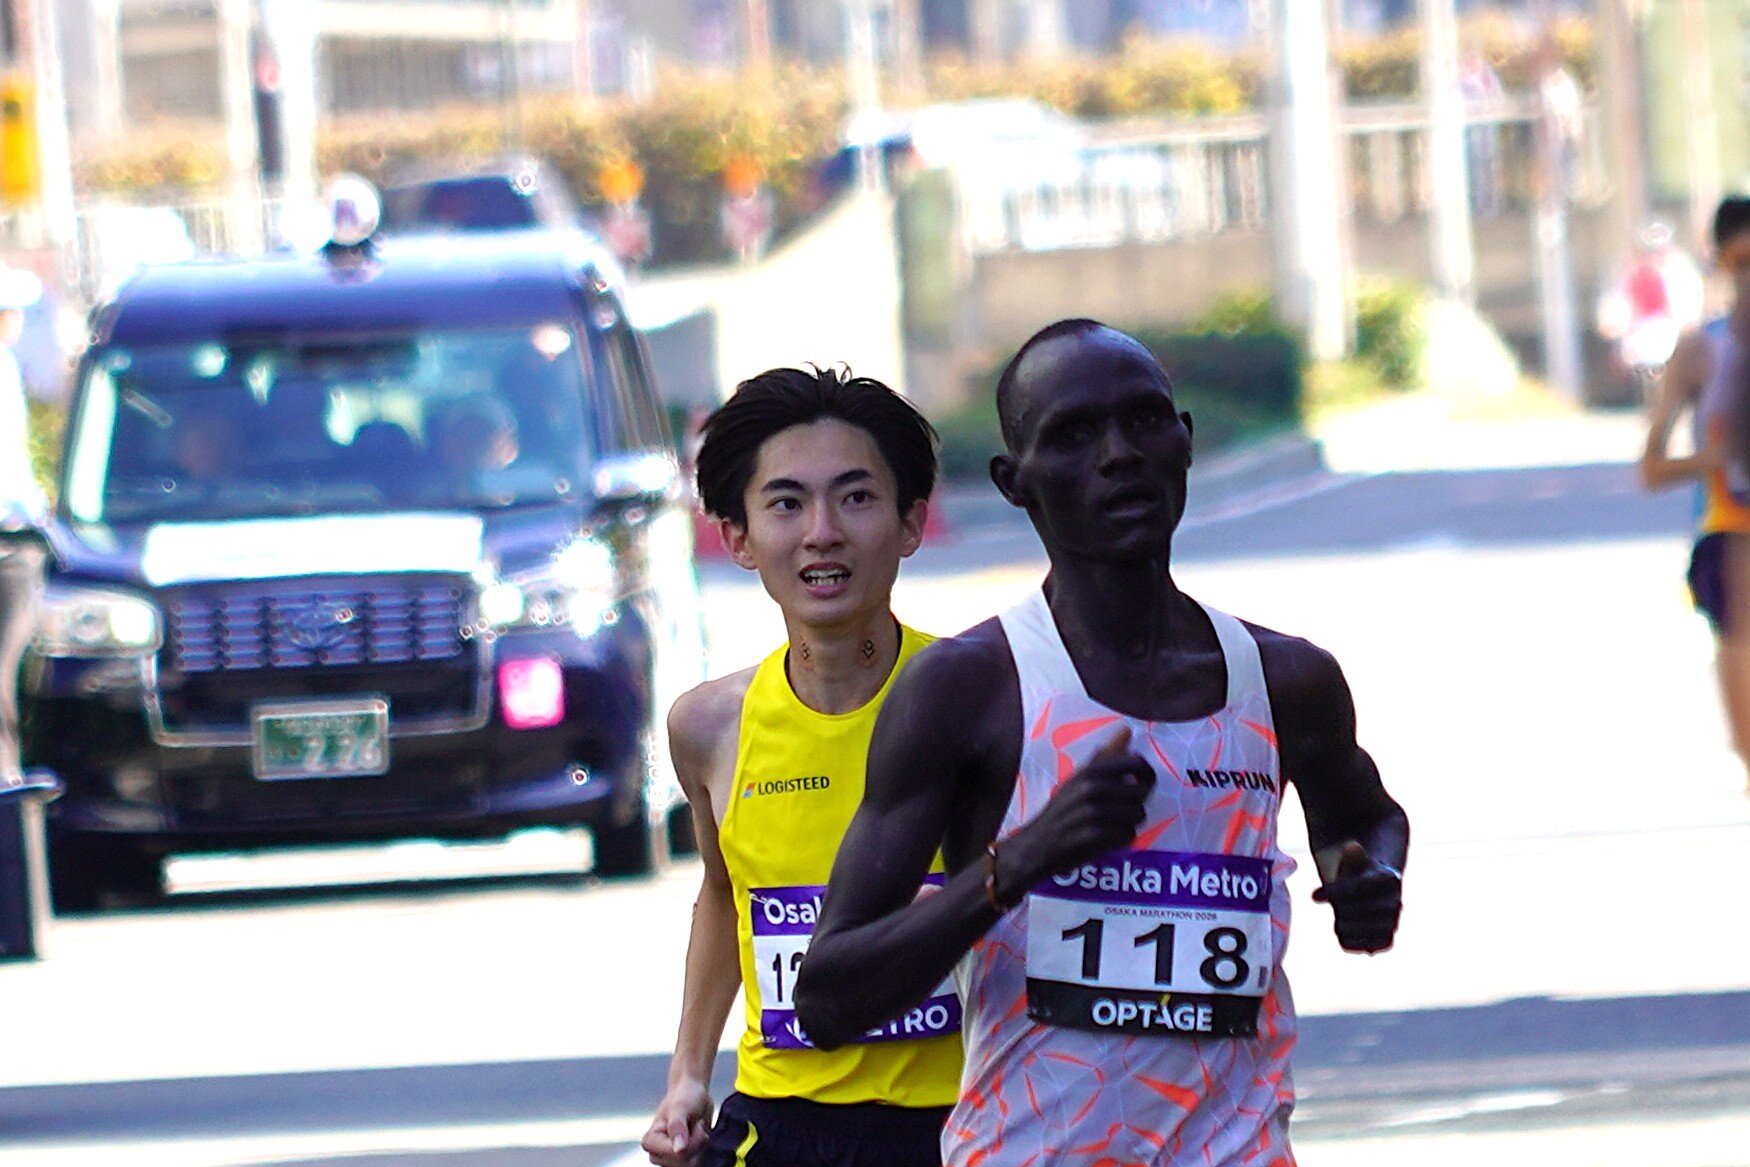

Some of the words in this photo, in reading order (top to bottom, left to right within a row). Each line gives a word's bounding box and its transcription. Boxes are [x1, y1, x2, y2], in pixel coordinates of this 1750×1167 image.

[757, 776, 830, 795] LOGISTEED
[1186, 768, 1276, 793] KIPRUN
[1169, 864, 1258, 900] Metro
[1104, 907, 1138, 917] OSAKA
[1139, 909, 1193, 921] MARATHON
[1061, 918, 1250, 989] 118
[1092, 999, 1213, 1032] OPTAGE
